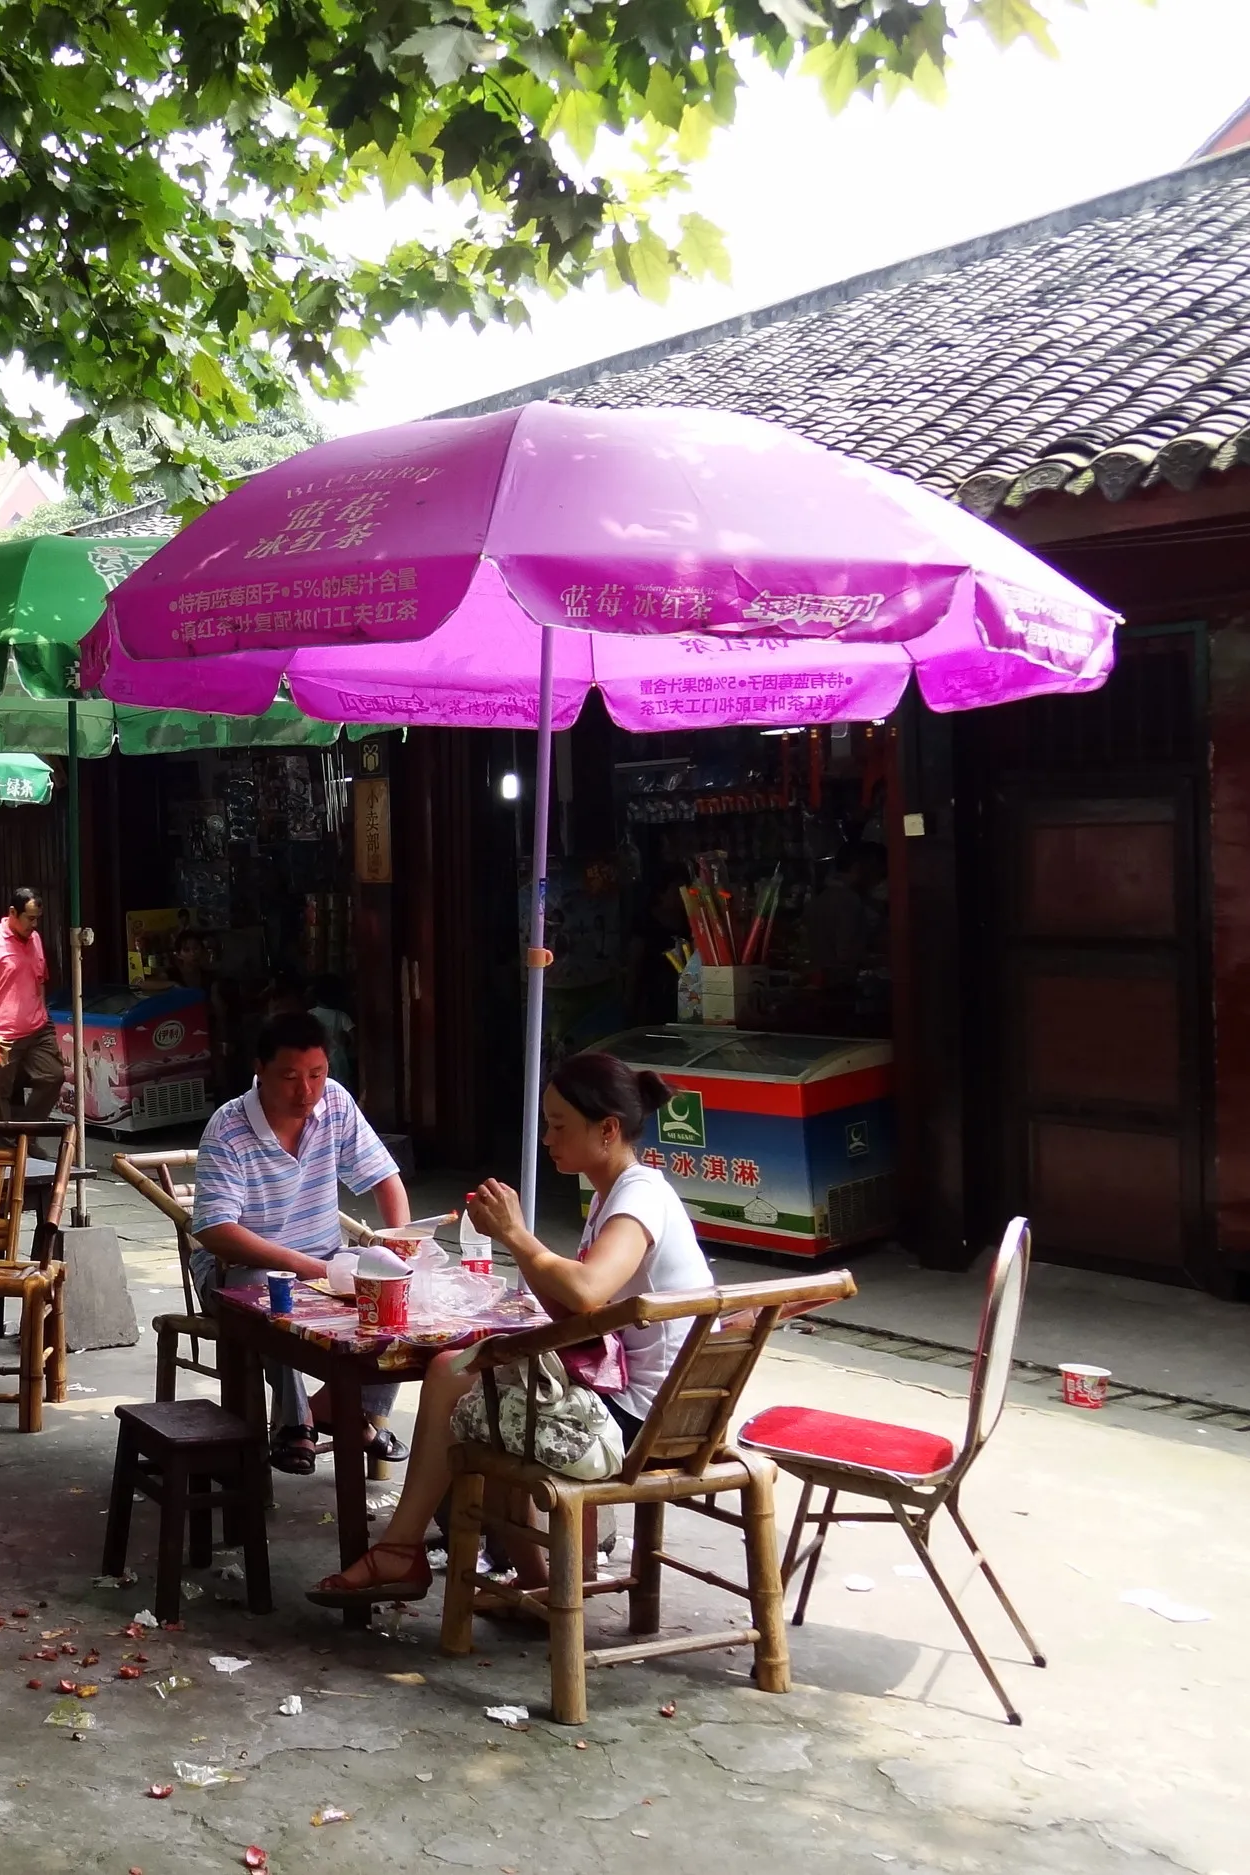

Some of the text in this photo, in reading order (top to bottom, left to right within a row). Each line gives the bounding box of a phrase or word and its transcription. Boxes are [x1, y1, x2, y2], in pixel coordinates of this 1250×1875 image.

[281, 490, 391, 531] 蓝莓
[243, 521, 382, 560] 冰红茶
[179, 598, 419, 642] 滇红茶叶复配祁门工夫红茶
[365, 788, 380, 854] 小卖部
[158, 1027, 179, 1042] 伊利
